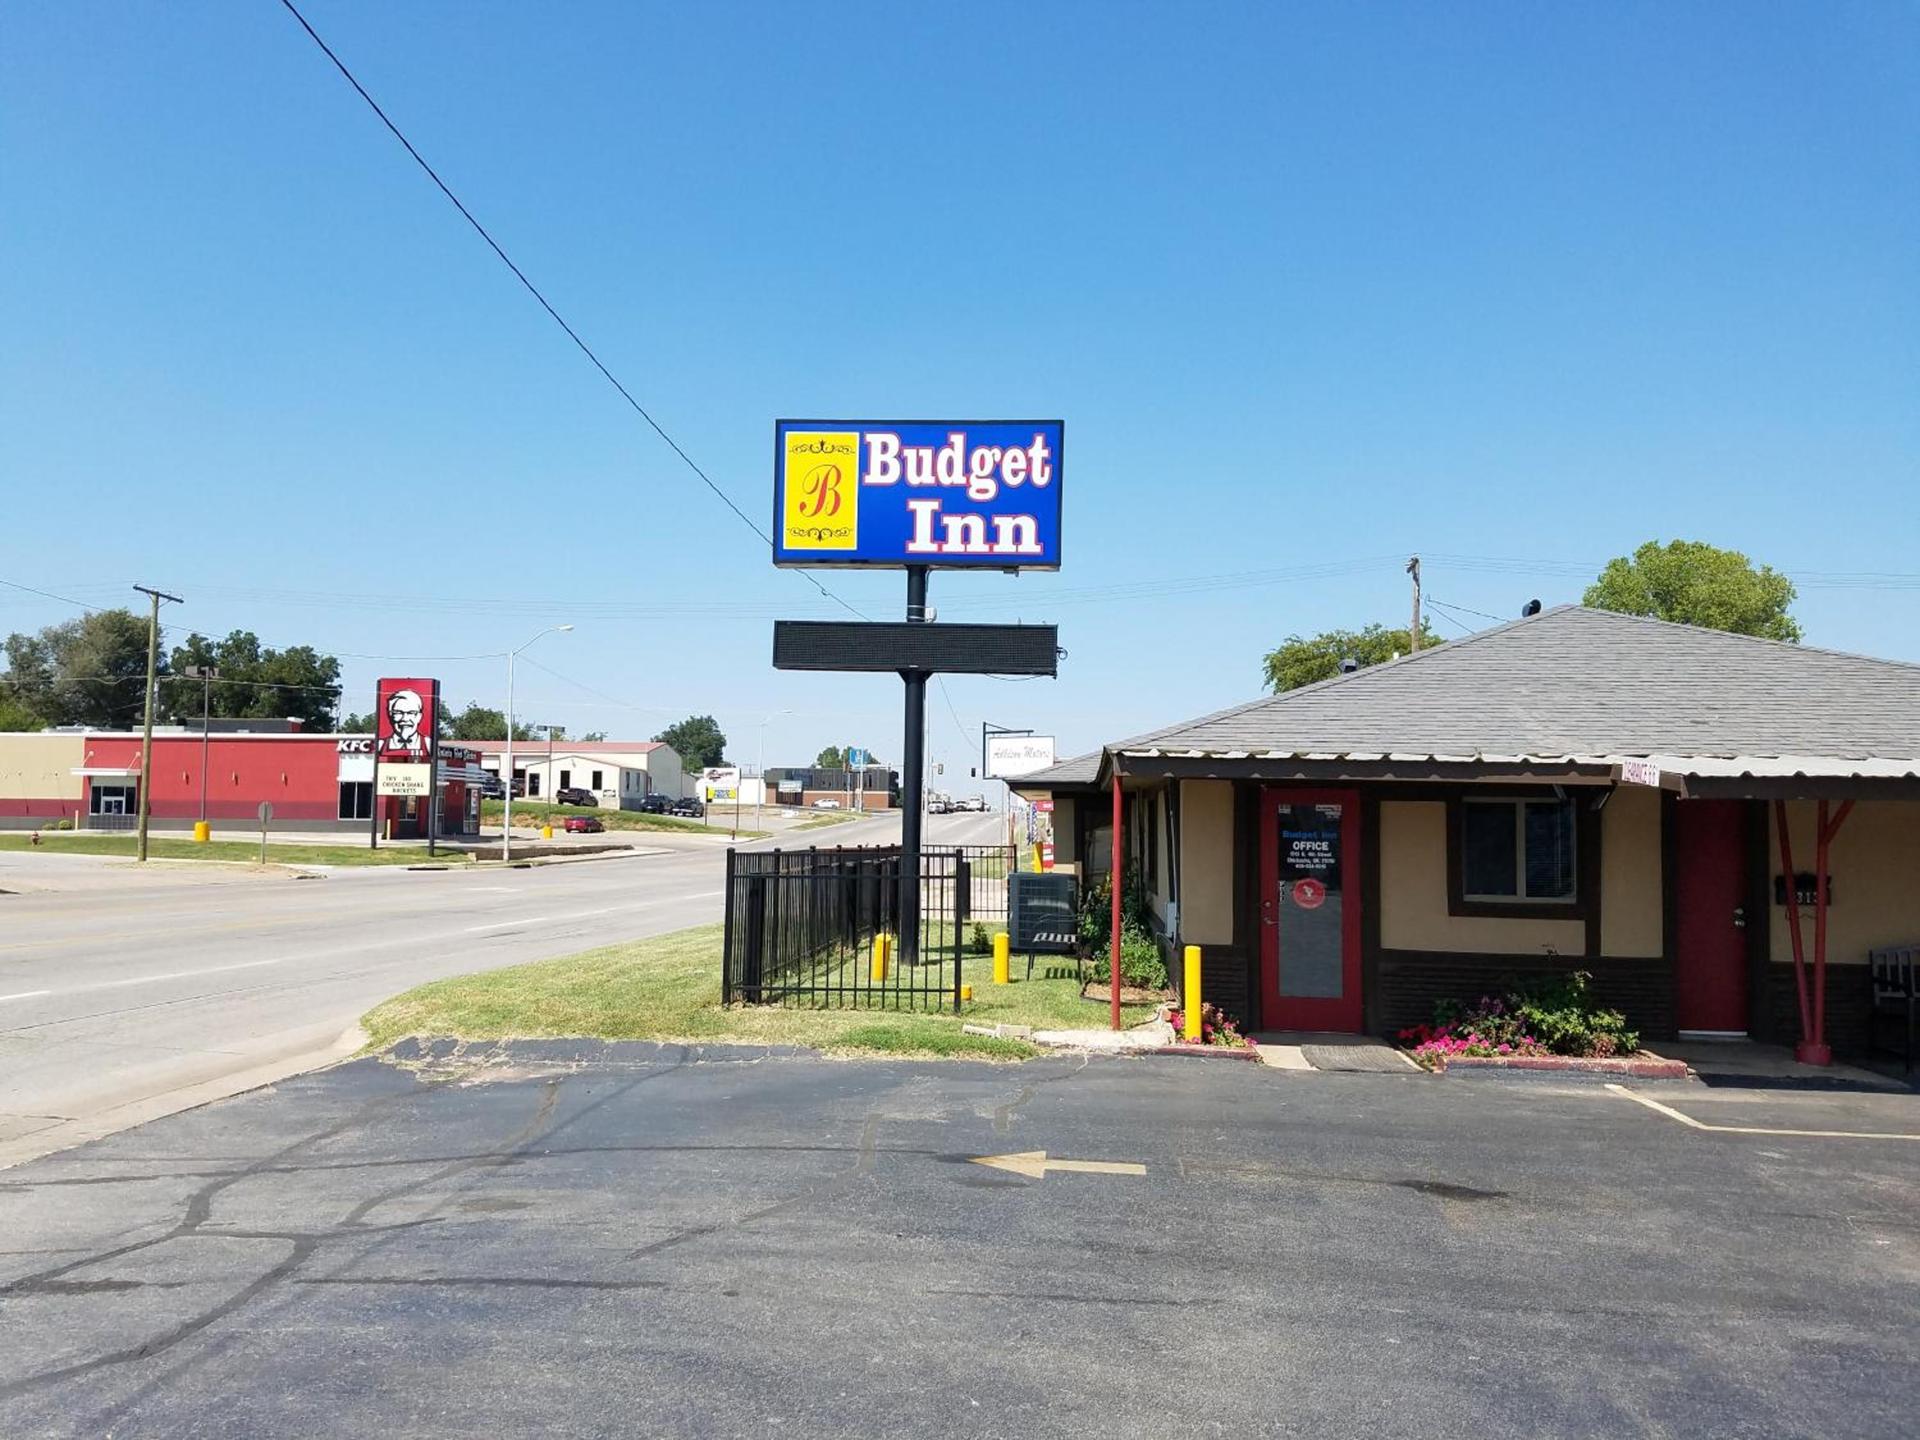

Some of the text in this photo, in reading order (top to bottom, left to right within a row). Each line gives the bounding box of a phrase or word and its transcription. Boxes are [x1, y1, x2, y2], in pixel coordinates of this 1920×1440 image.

[799, 464, 843, 518] B
[862, 431, 1052, 501] Budget
[906, 498, 1044, 554] Inn
[336, 740, 372, 752] KFC
[1292, 841, 1329, 850] OFFICE
